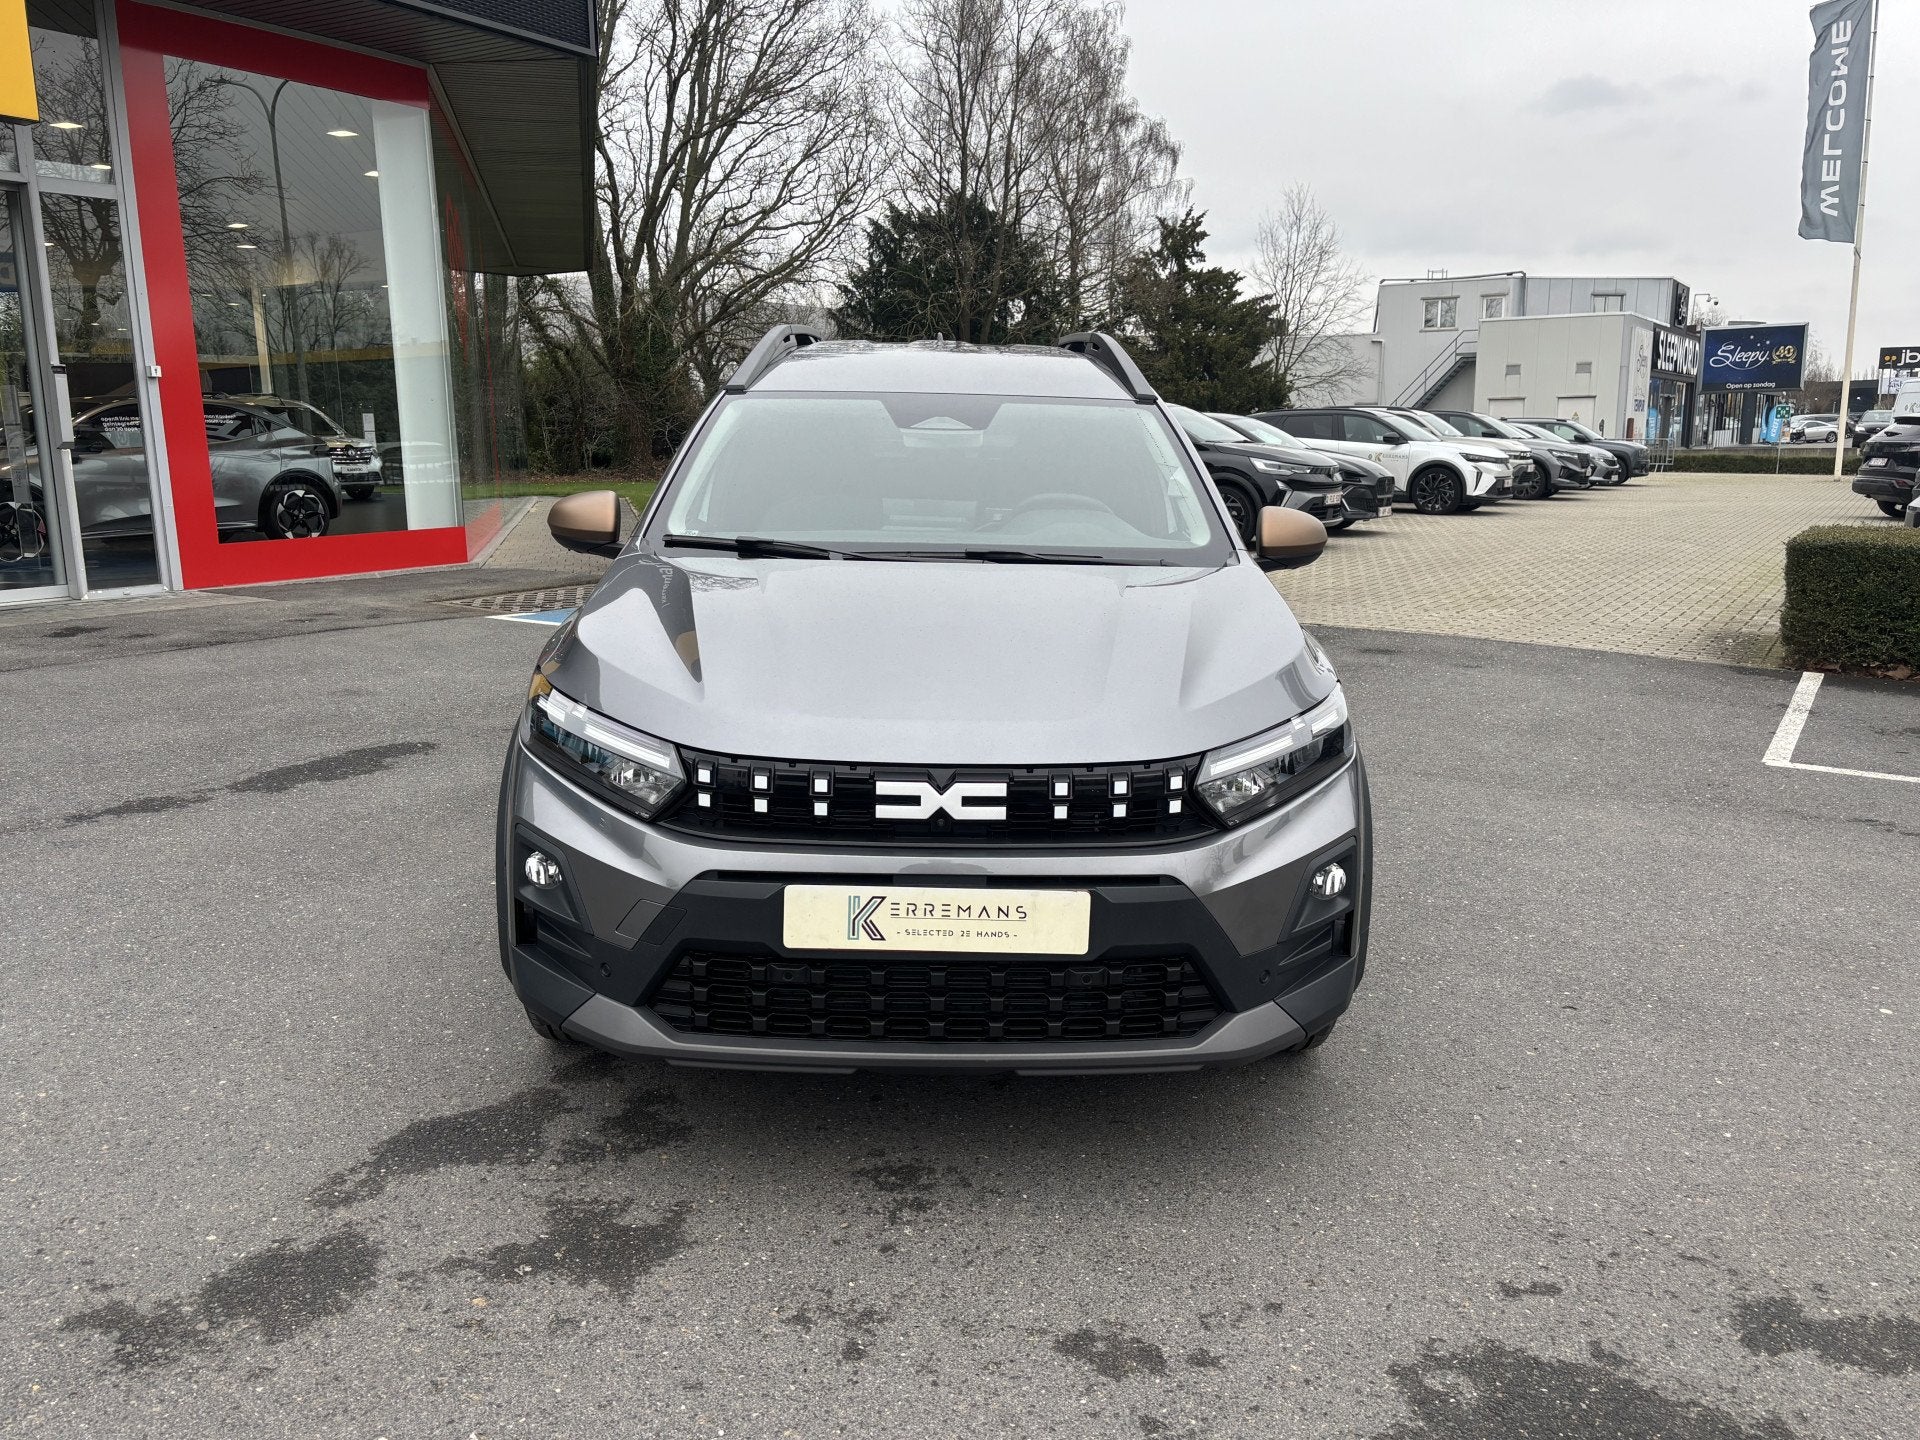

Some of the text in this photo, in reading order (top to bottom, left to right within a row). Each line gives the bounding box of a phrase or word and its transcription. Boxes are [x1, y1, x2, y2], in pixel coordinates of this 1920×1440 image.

[1657, 330, 1700, 376] SLEEPWORLD
[1709, 341, 1770, 370] Sleepy
[847, 895, 1027, 942] KERREMANS
[905, 929, 954, 938] SELECTED
[976, 930, 1010, 939] HANDS
